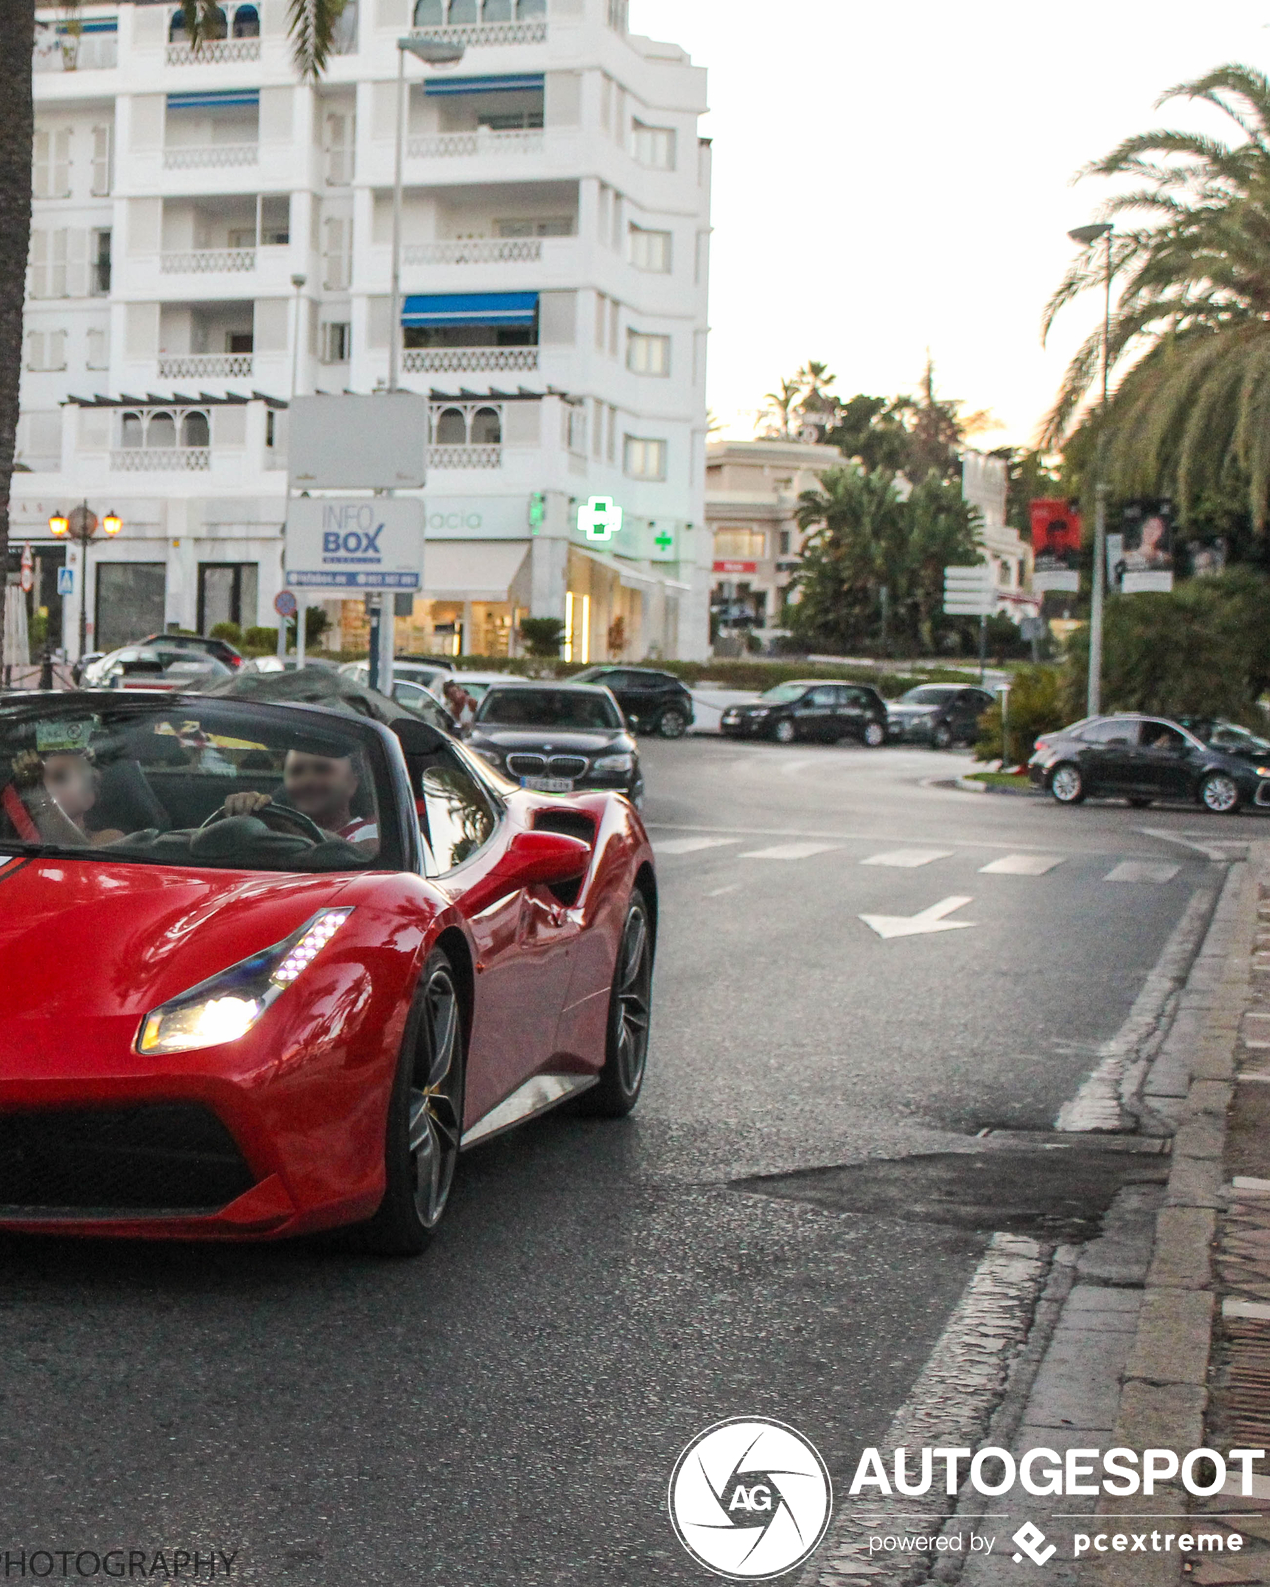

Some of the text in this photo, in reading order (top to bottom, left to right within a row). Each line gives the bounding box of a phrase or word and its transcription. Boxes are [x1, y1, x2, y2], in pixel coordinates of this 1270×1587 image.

[323, 504, 374, 530] INFO
[429, 511, 482, 529] acia
[322, 522, 385, 553] BOX
